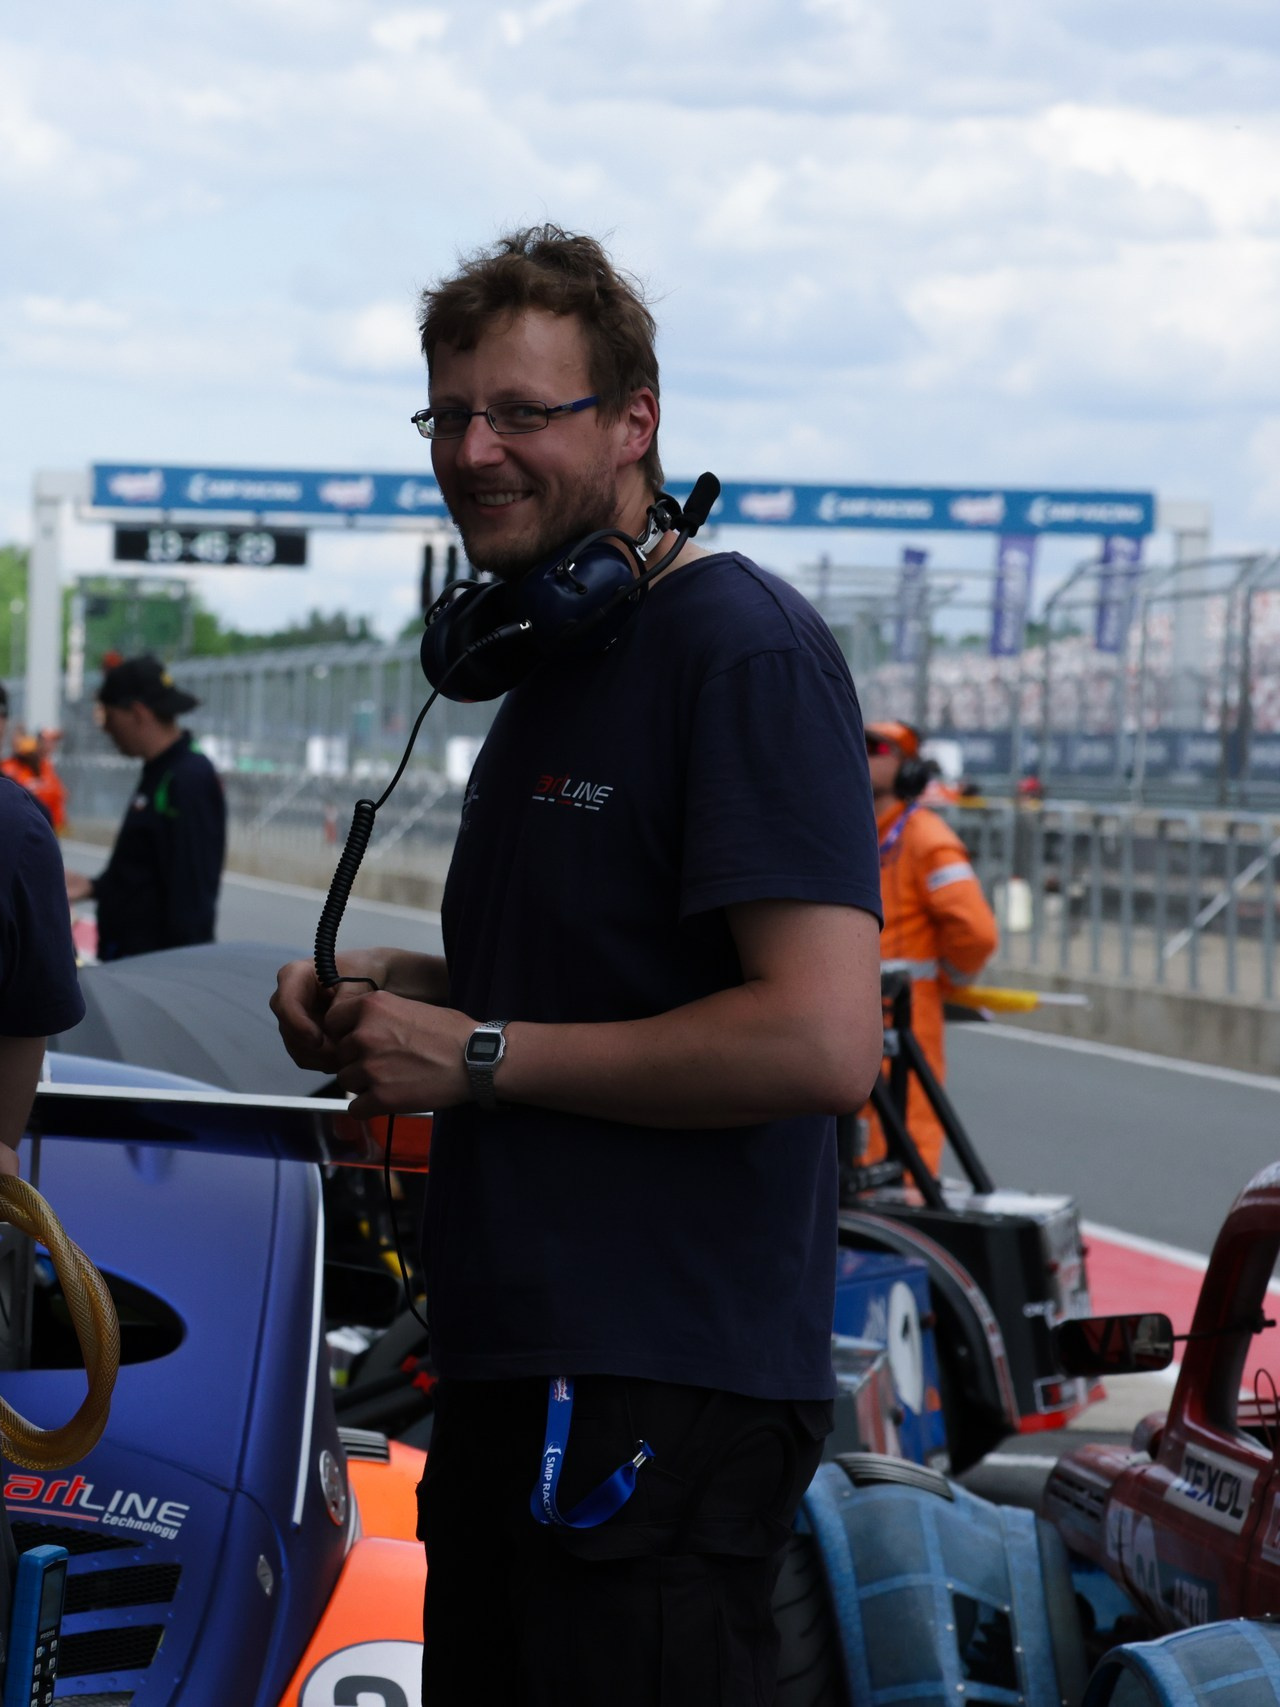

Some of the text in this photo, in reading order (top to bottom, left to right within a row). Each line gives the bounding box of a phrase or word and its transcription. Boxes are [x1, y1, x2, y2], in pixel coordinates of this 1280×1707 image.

[544, 1457, 556, 1481] SMP
[3, 1474, 190, 1528] artLINE
[101, 1512, 179, 1541] technology
